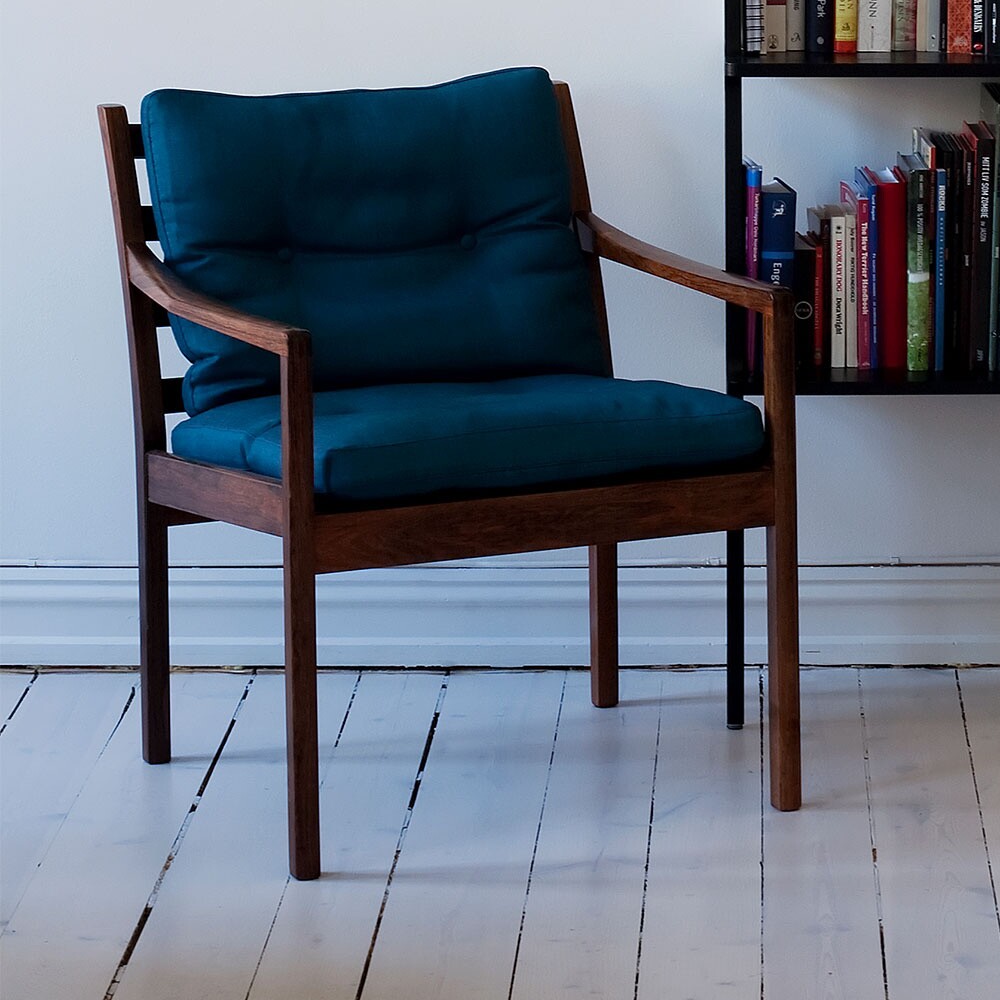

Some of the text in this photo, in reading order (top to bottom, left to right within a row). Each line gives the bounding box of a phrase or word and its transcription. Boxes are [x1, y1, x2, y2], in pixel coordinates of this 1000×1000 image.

[816, 0, 827, 18] Park
[981, 157, 990, 171] MITT
[981, 172, 989, 182] LIV
[981, 183, 989, 196] SOM
[980, 196, 989, 218] ZOMBIE
[861, 252, 869, 278] Terrier
[861, 279, 869, 315] Handbook
[835, 313, 843, 335] Wright
